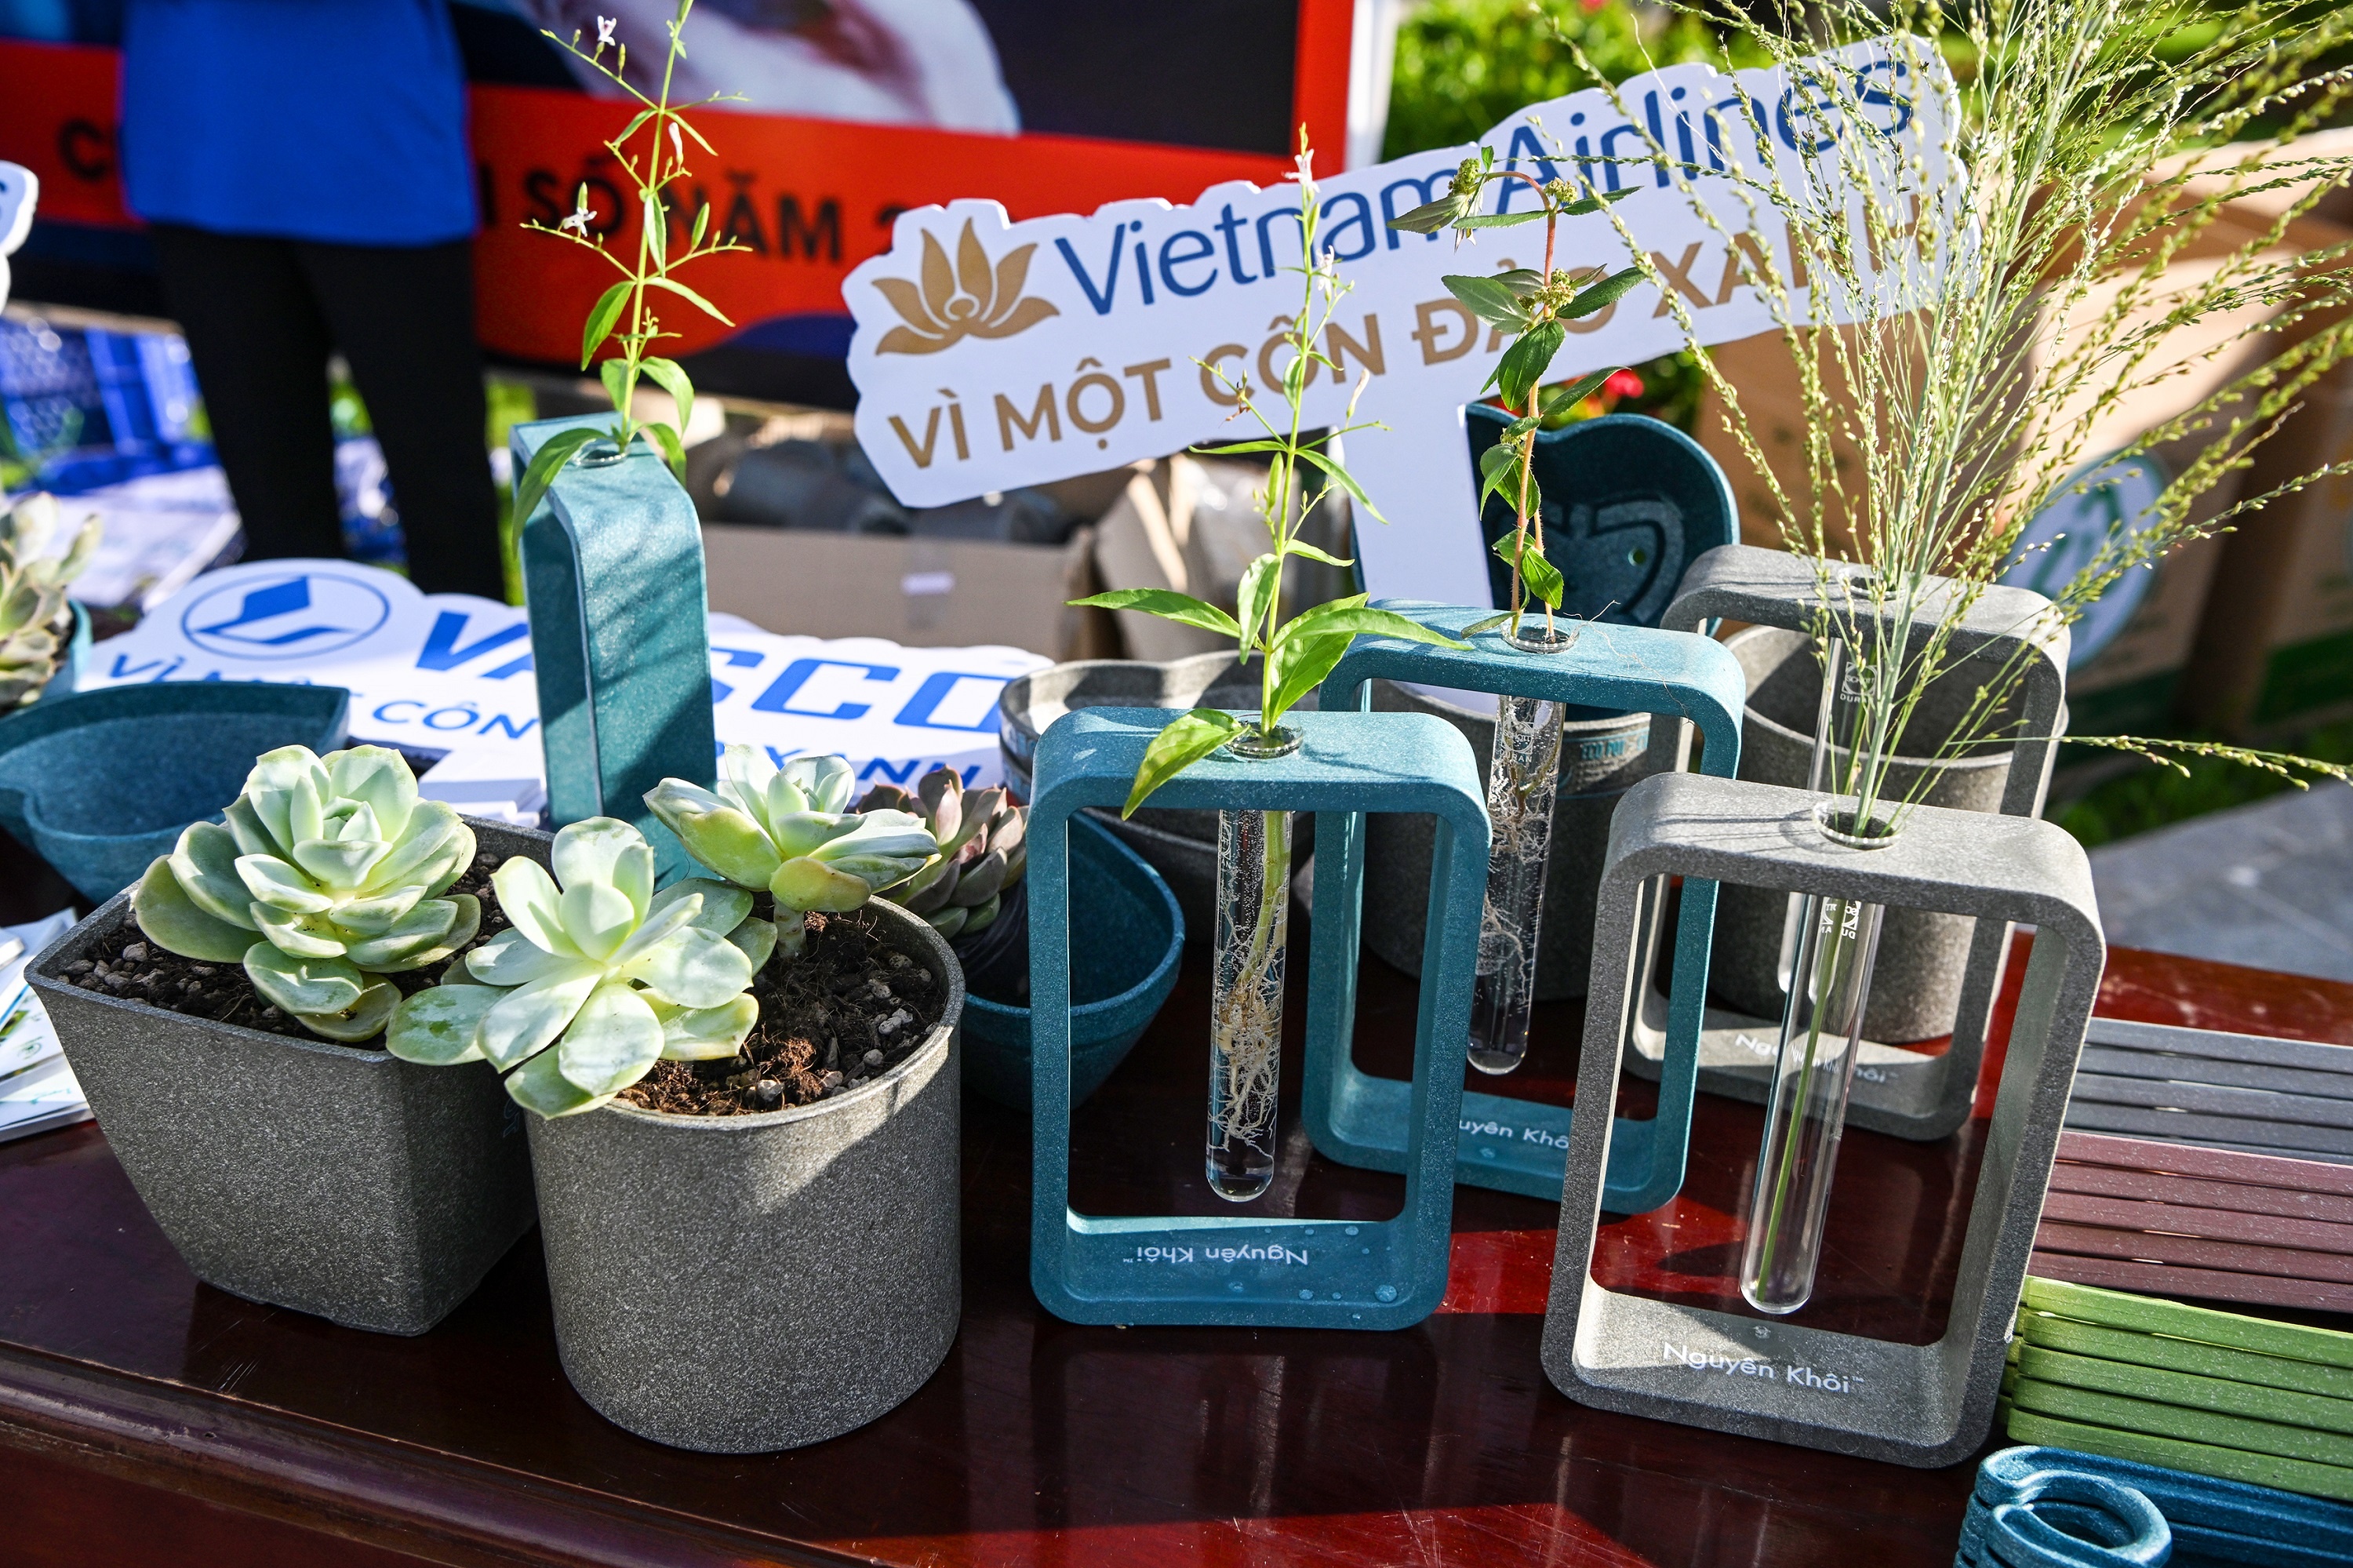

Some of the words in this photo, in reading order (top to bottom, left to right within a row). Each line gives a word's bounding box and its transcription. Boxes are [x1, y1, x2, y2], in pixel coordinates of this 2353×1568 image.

[1054, 167, 1478, 315] Vietnam
[1496, 60, 1911, 214] Airlines
[889, 389, 969, 468] VÌ
[995, 357, 1171, 450] MỘT
[1199, 314, 1387, 407] CÔN
[373, 701, 540, 739] CÔN
[1522, 1127, 1569, 1149] Khô
[1663, 1341, 1775, 1380] Nguyên
